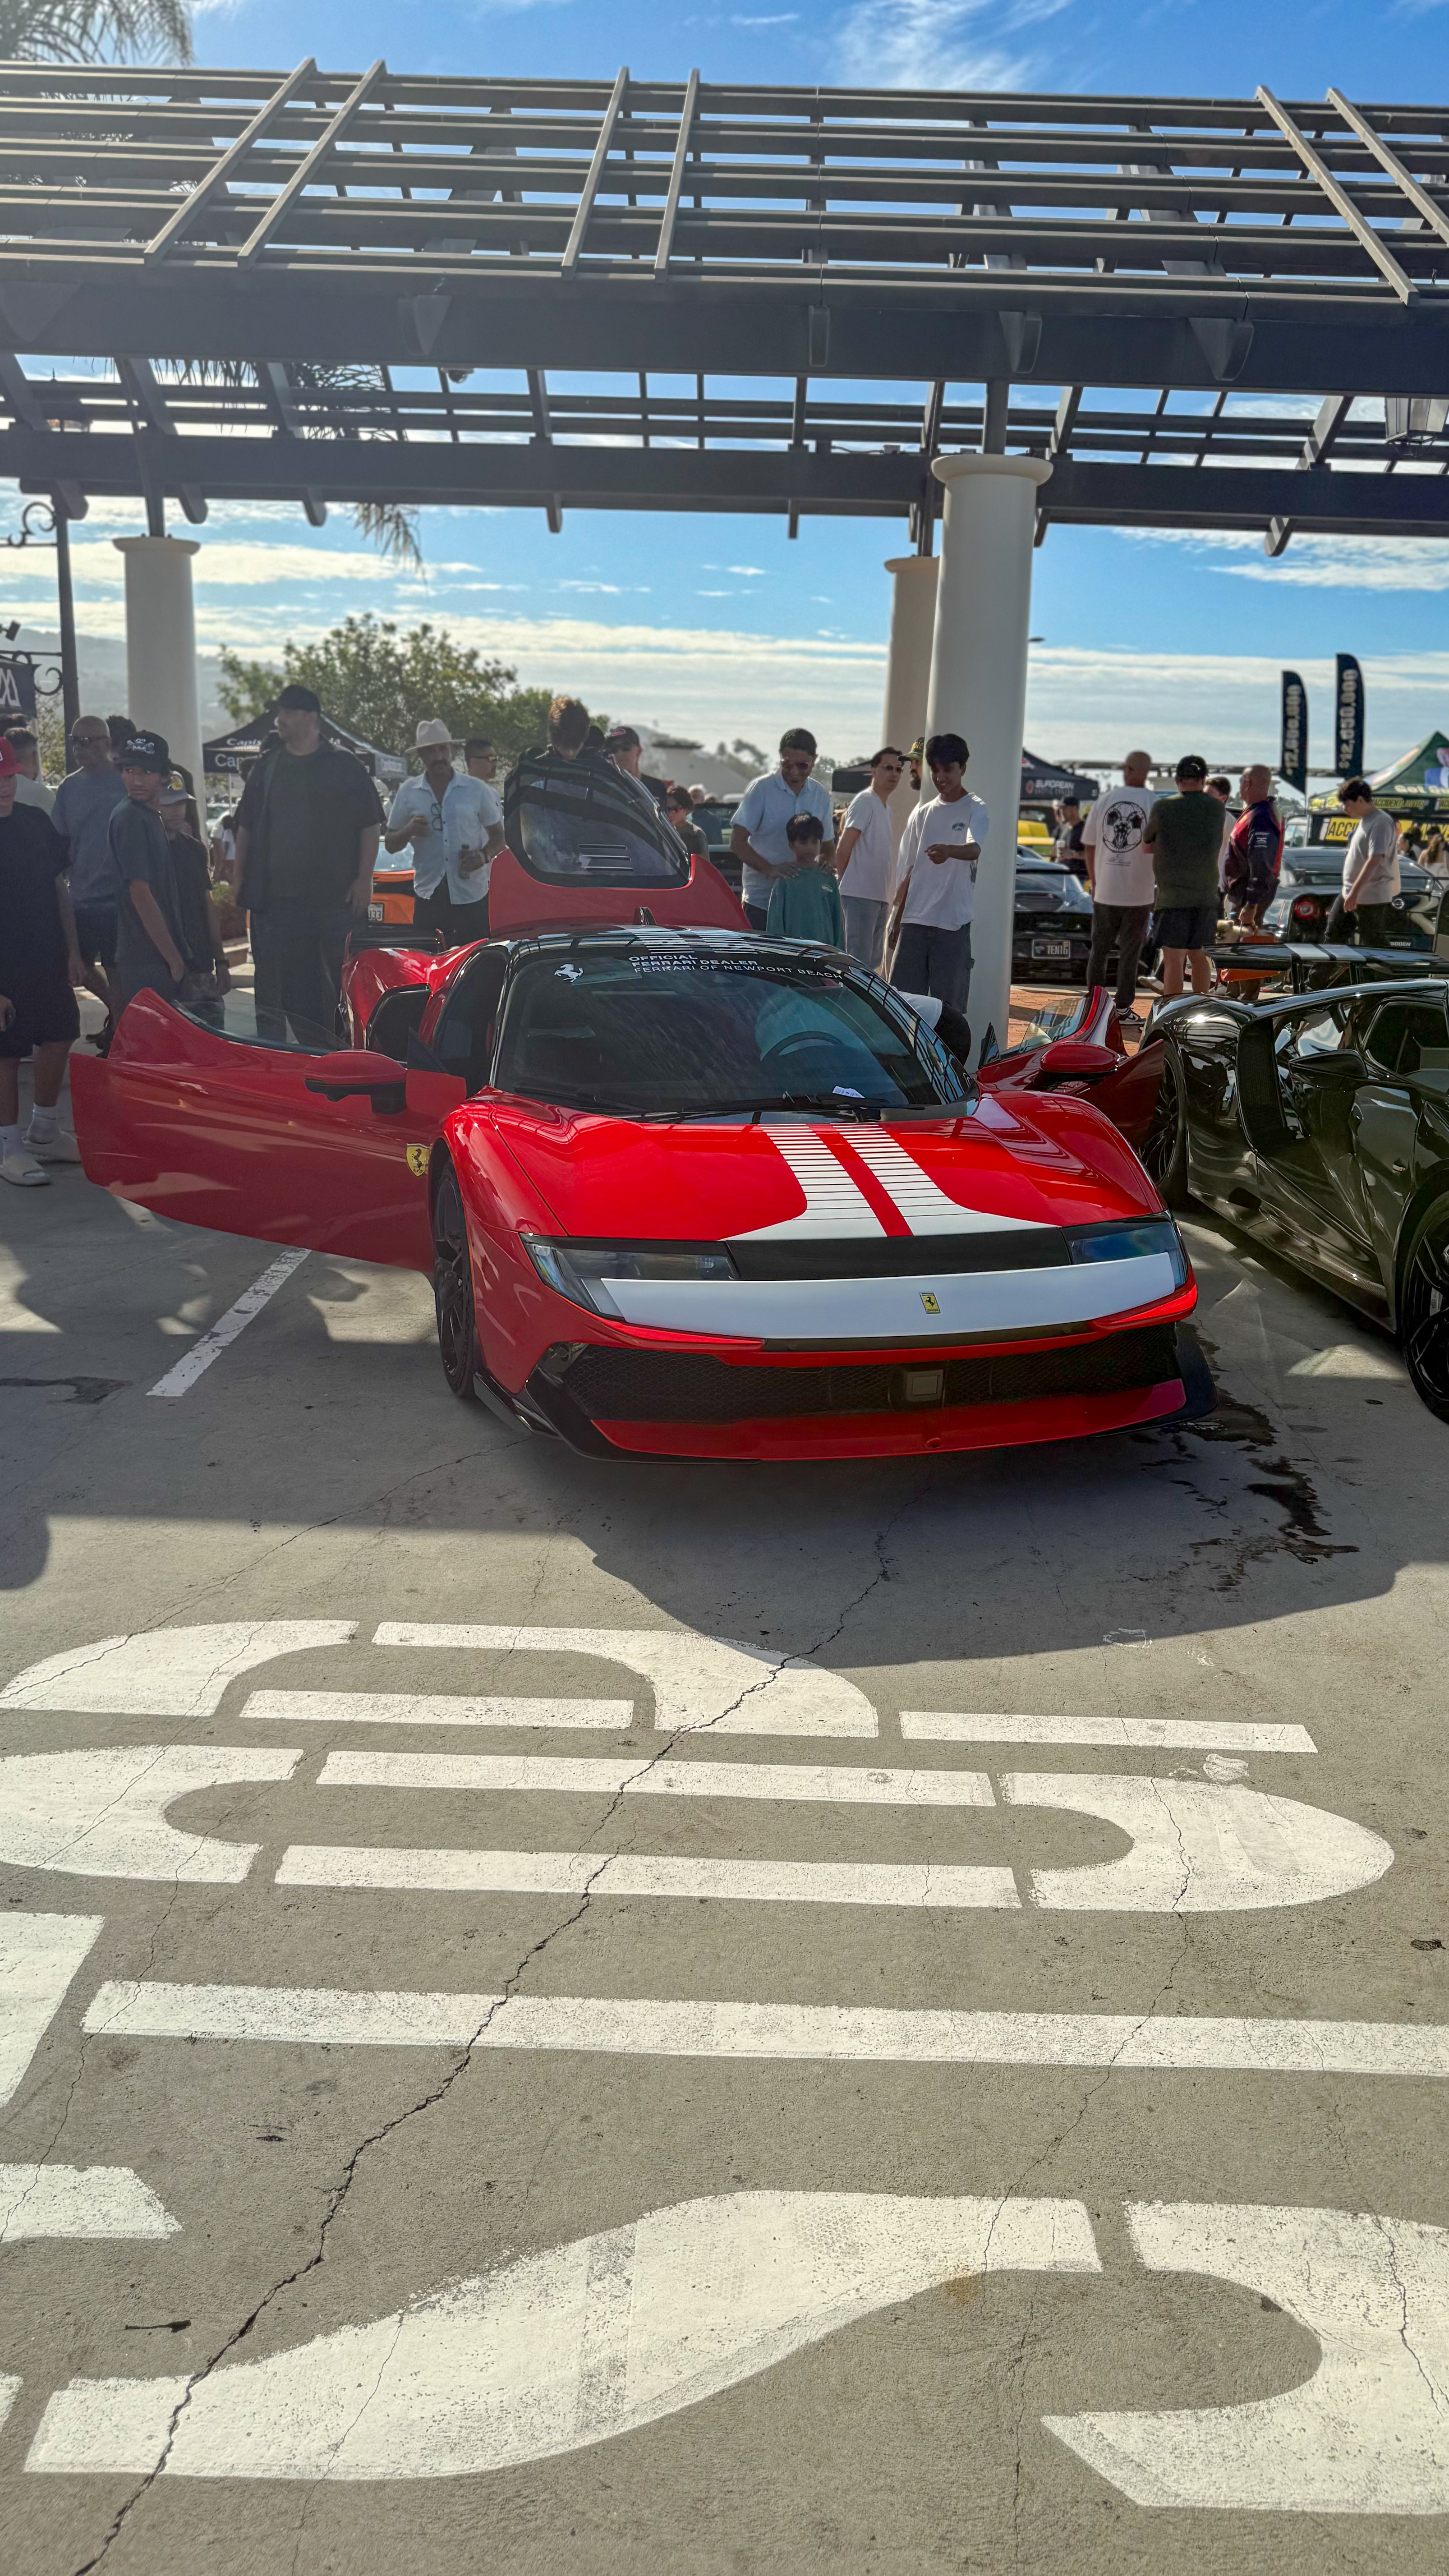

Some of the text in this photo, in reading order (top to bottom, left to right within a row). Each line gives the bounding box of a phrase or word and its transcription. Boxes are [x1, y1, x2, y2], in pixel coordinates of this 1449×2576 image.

[1035, 779, 1074, 789] EUROPEAN
[1046, 945, 1068, 955] TEN16
[634, 965, 695, 973] FERRARI
[724, 966, 793, 974] NEWPORT
[797, 969, 842, 980] BEACH
